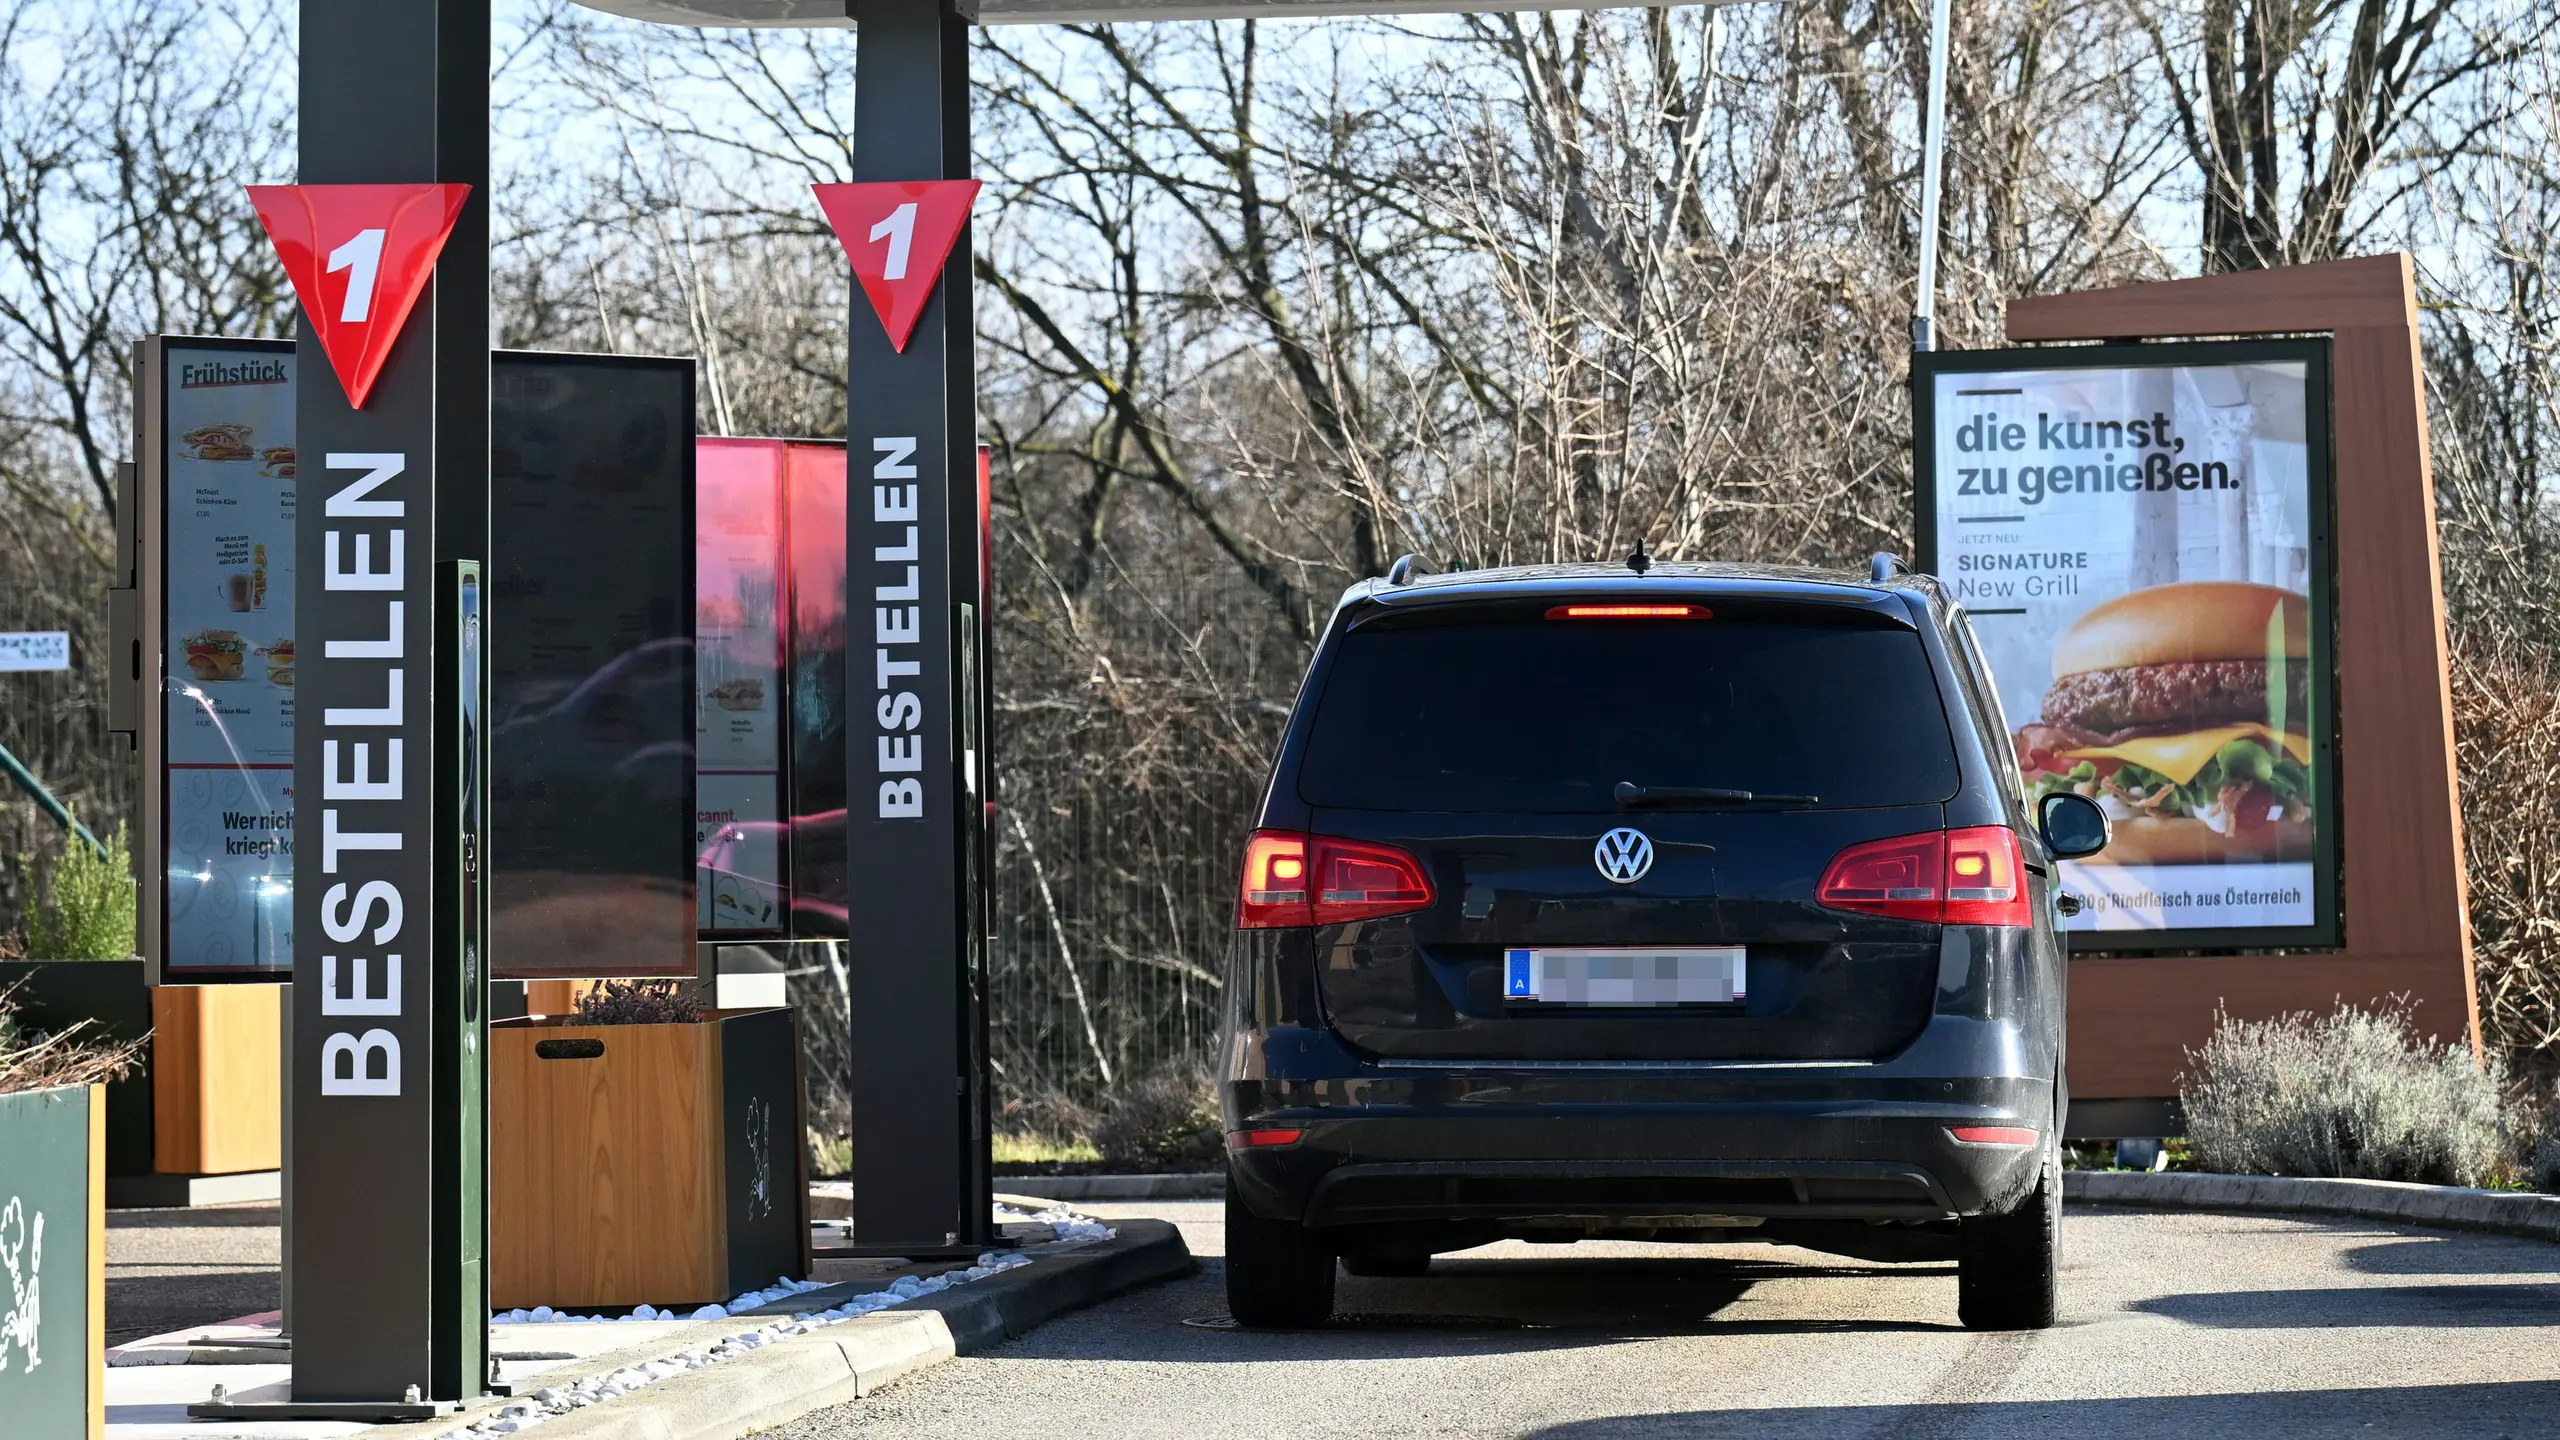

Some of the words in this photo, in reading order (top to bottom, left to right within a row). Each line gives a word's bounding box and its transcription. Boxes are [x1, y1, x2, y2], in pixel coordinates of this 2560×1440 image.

[869, 202, 917, 281] 1
[326, 229, 385, 323] 1
[182, 360, 286, 386] Frühstück
[1956, 412, 2026, 452] die
[2038, 412, 2184, 454] kunst,
[1957, 467, 2008, 496] zu
[2017, 452, 2240, 505] genießen.
[1958, 534, 1992, 544] JETZT
[1958, 552, 2088, 571] SIGNATURE
[1959, 577, 2015, 598] New
[2025, 574, 2078, 597] Grill
[873, 437, 923, 819] BESTELLEN
[321, 453, 405, 1096] BESTELLEN
[222, 811, 256, 830] Wer
[260, 811, 294, 830] nich
[698, 809, 738, 823] cannt,
[226, 837, 276, 860] kriegt
[1597, 829, 1652, 883] VW
[2112, 890, 2192, 909] Rindfleisch
[2196, 893, 2221, 907] aus
[2225, 887, 2301, 906] Österreich
[1515, 979, 1525, 989] A
